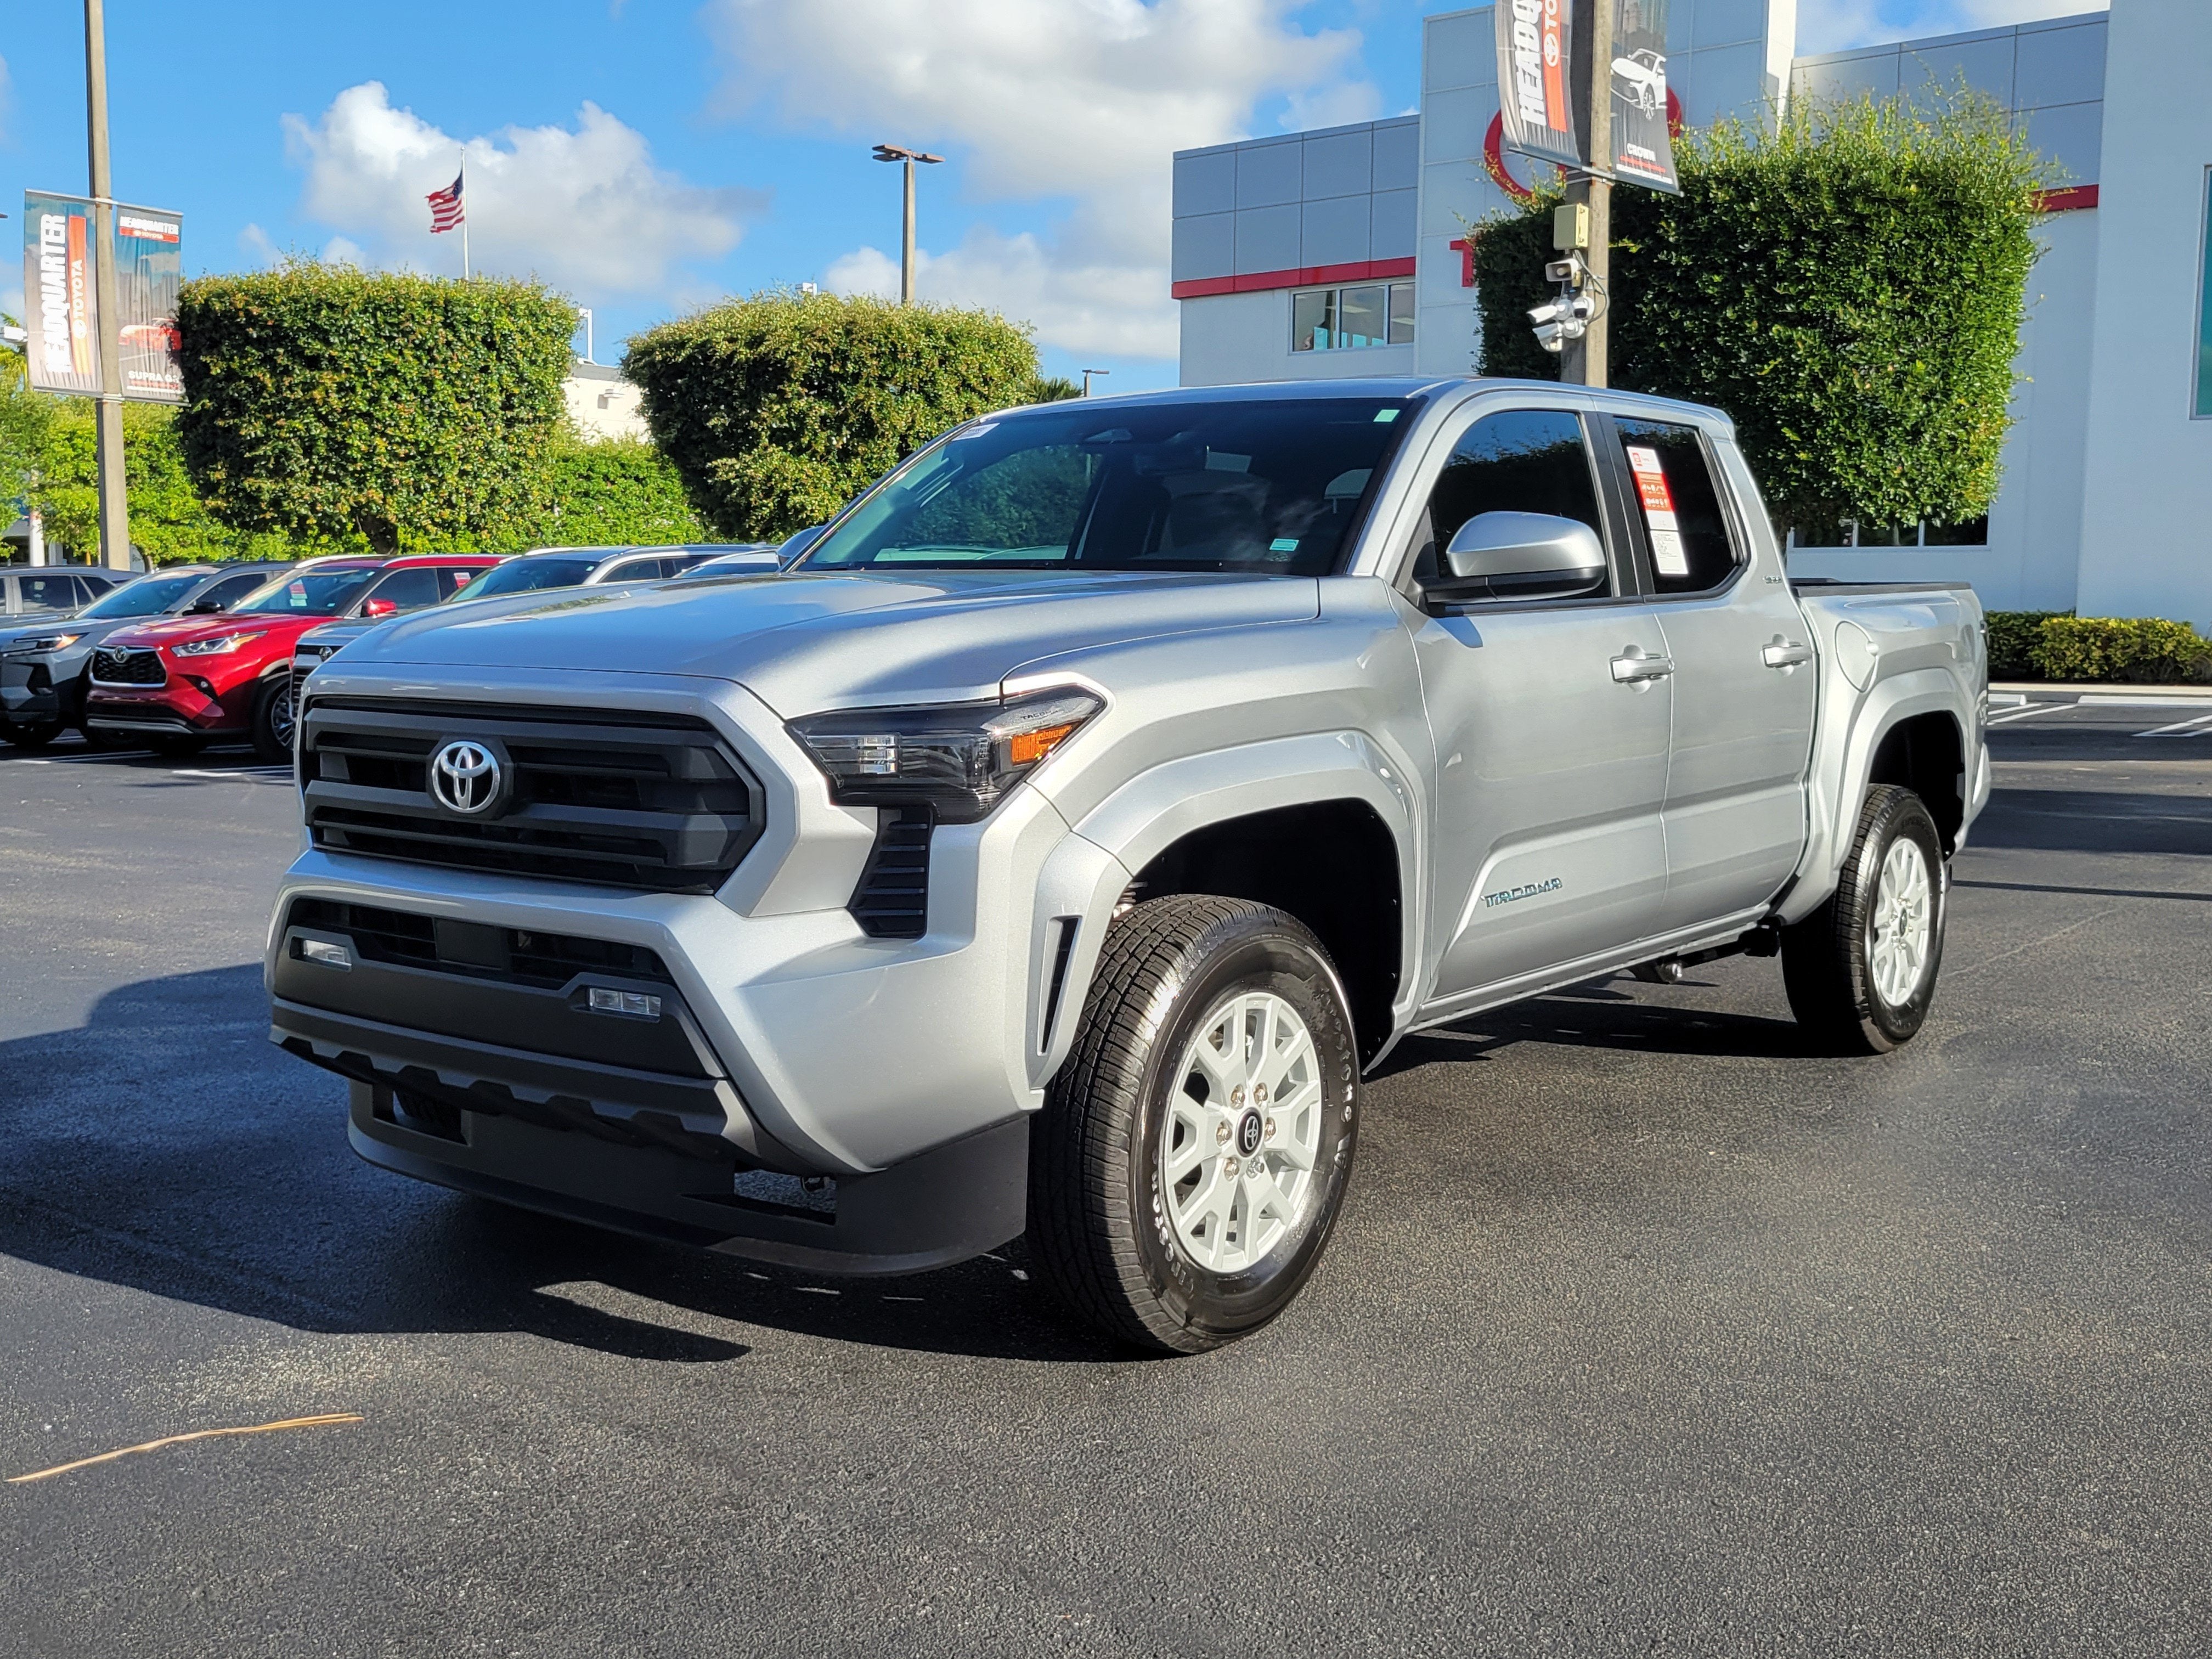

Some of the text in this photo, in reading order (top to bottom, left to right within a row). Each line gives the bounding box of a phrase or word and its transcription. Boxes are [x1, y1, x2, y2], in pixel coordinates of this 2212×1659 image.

[1627, 143, 1656, 162] CROWN
[41, 214, 72, 373] HEADQUARTER
[71, 259, 84, 319] TOYOTA
[128, 370, 164, 382] SUPRA
[1481, 877, 1563, 908] TACOMA
